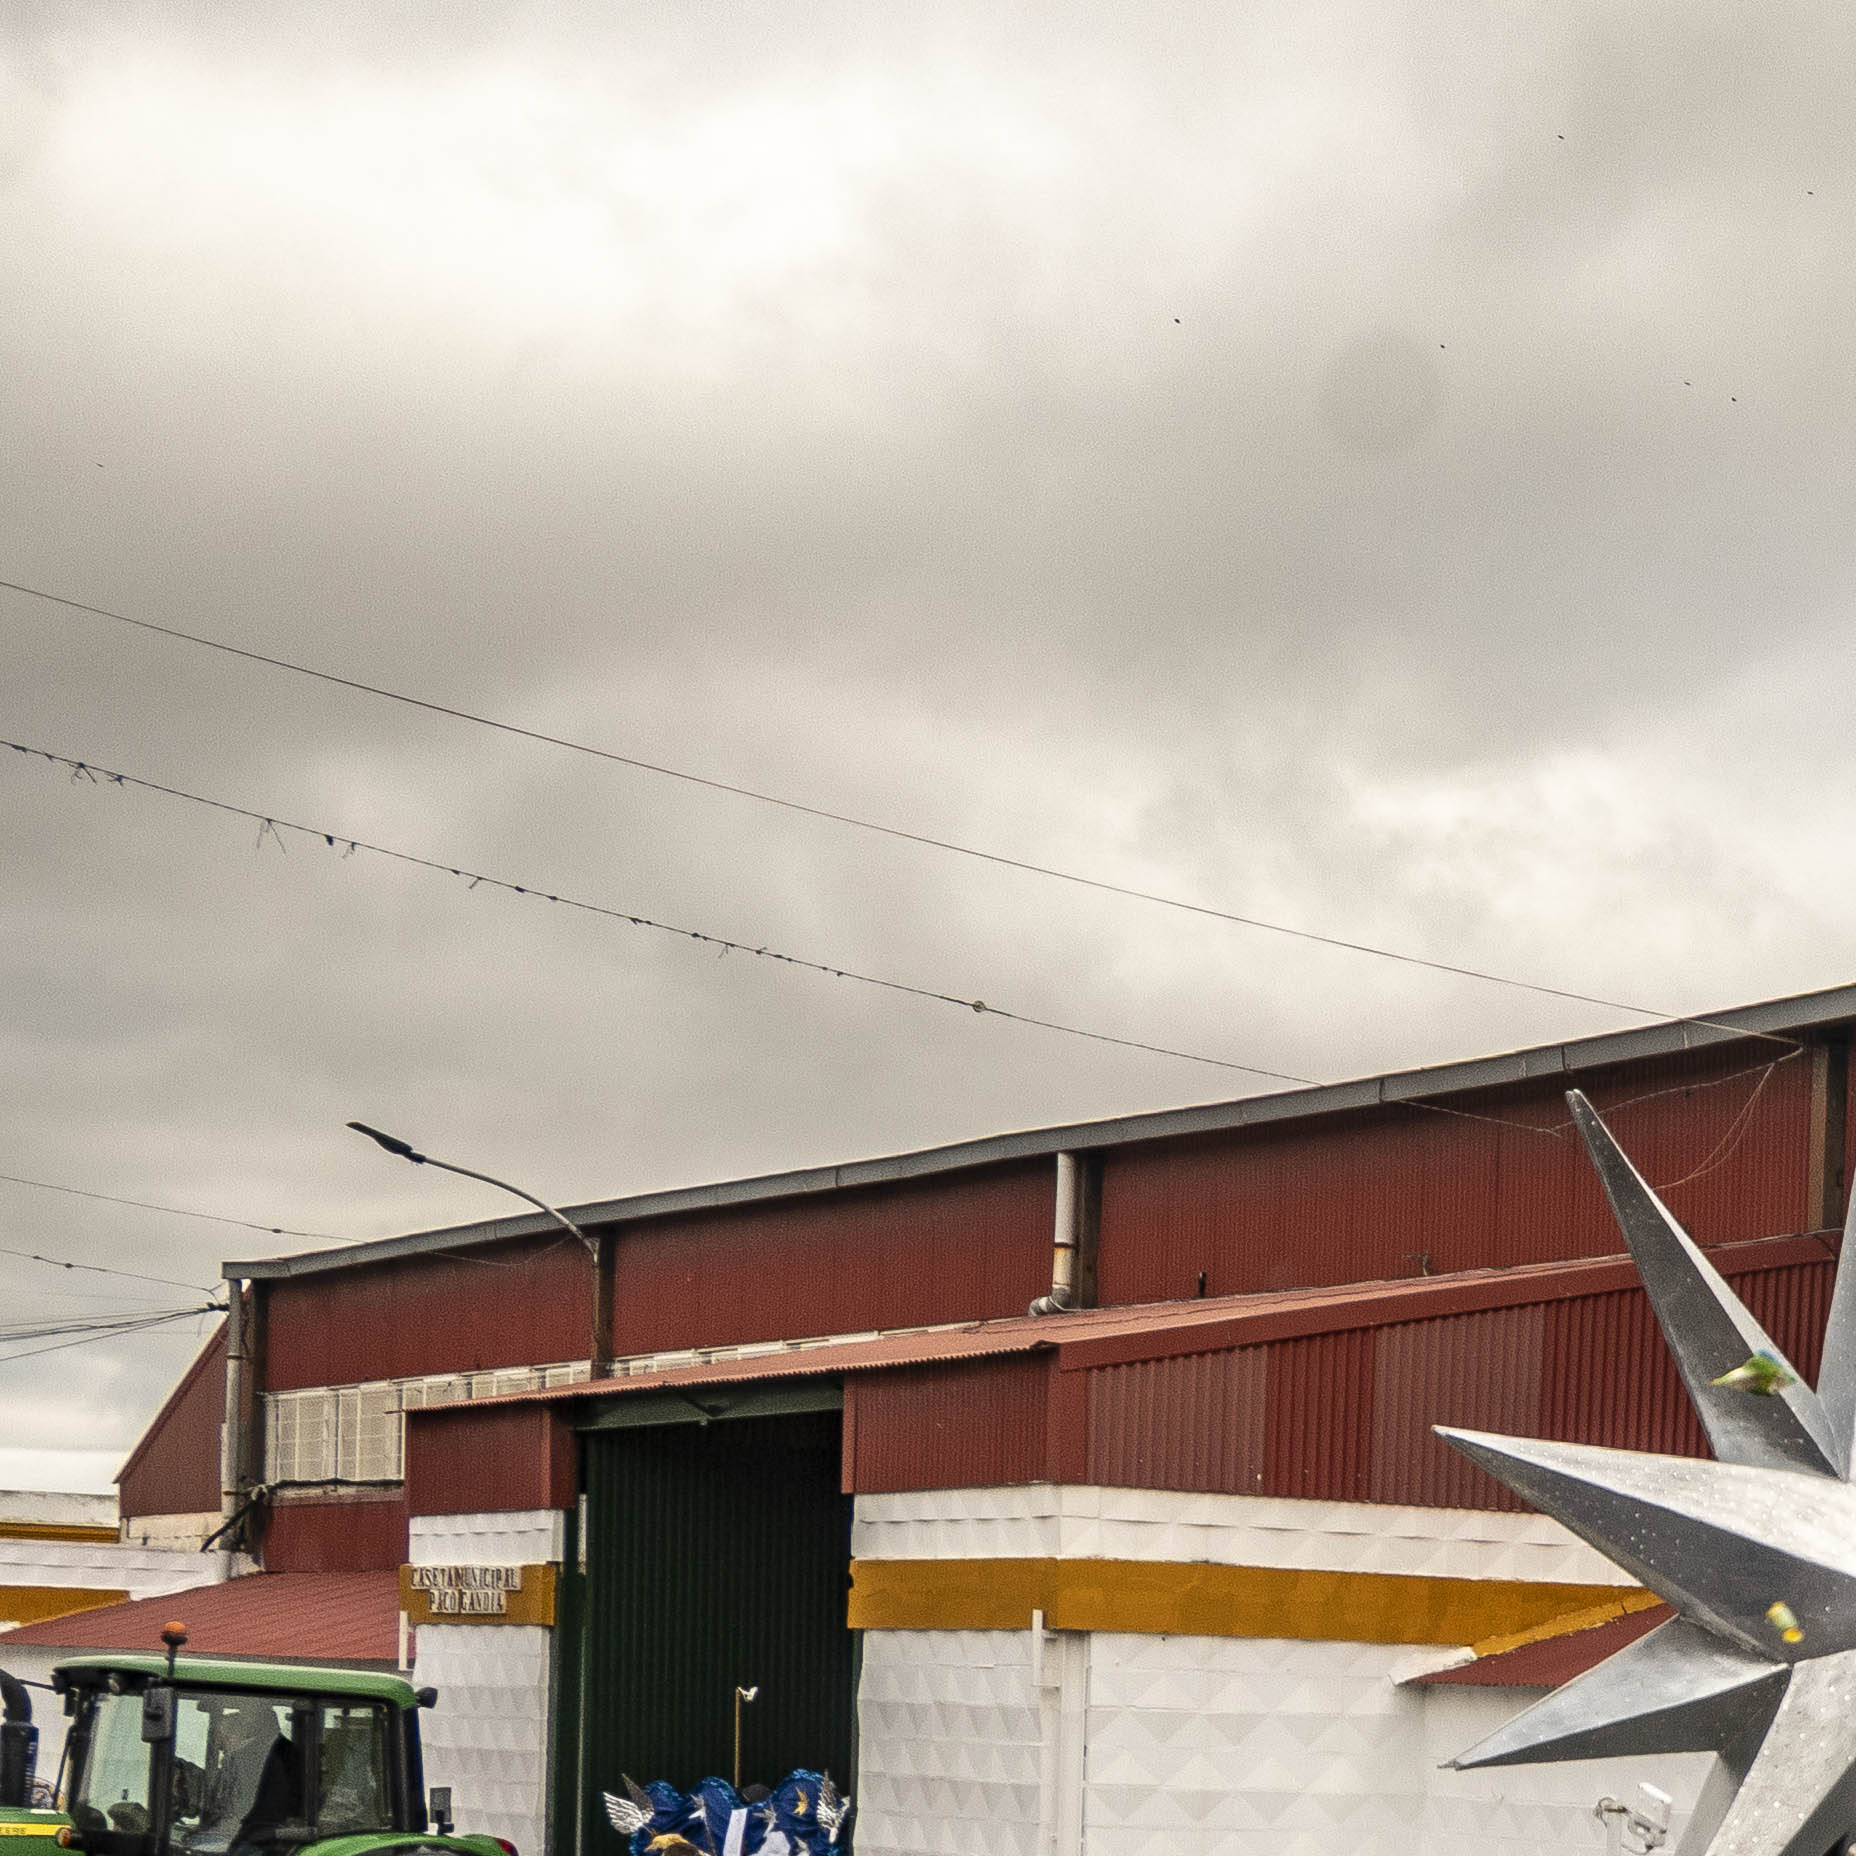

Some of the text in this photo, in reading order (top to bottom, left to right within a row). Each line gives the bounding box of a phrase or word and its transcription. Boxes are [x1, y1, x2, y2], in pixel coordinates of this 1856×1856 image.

[411, 1567, 518, 1589] CASETA MUNICIPAL
[429, 1591, 456, 1611] PACO
